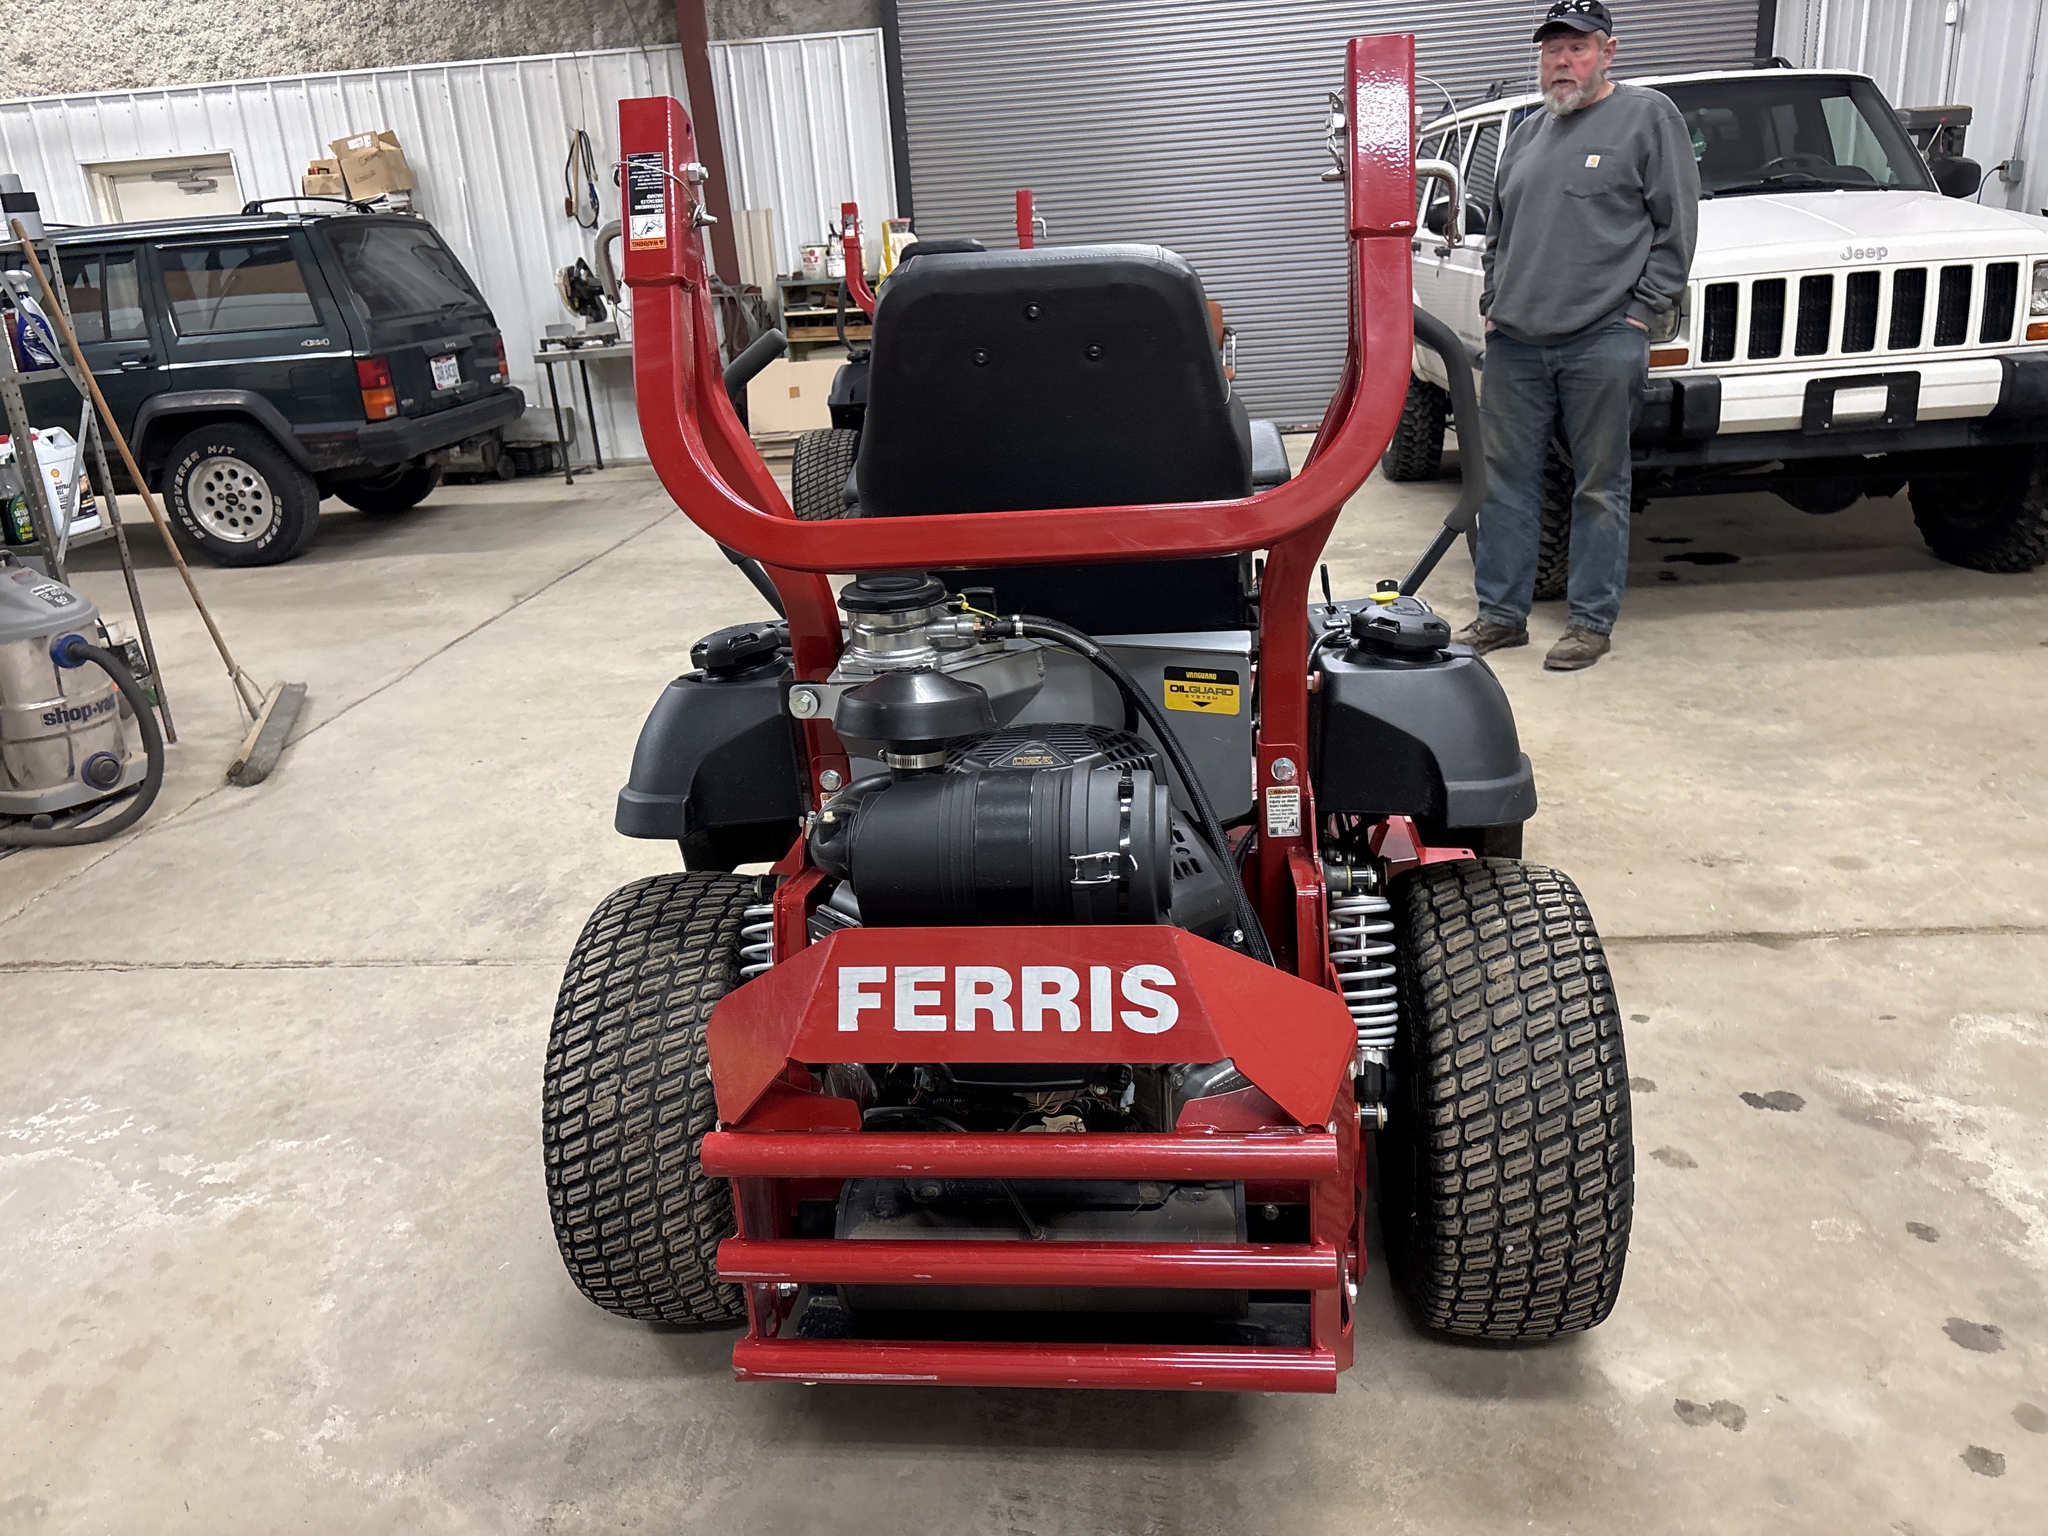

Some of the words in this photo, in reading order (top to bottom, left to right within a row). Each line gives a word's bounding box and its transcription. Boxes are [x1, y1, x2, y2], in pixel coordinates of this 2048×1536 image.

[632, 240, 659, 248] WARNING
[1840, 246, 1888, 261] Jeep
[1186, 671, 1217, 680] VANGUARD
[1170, 684, 1233, 696] OILGUARD
[837, 964, 1180, 1035] FERRIS
